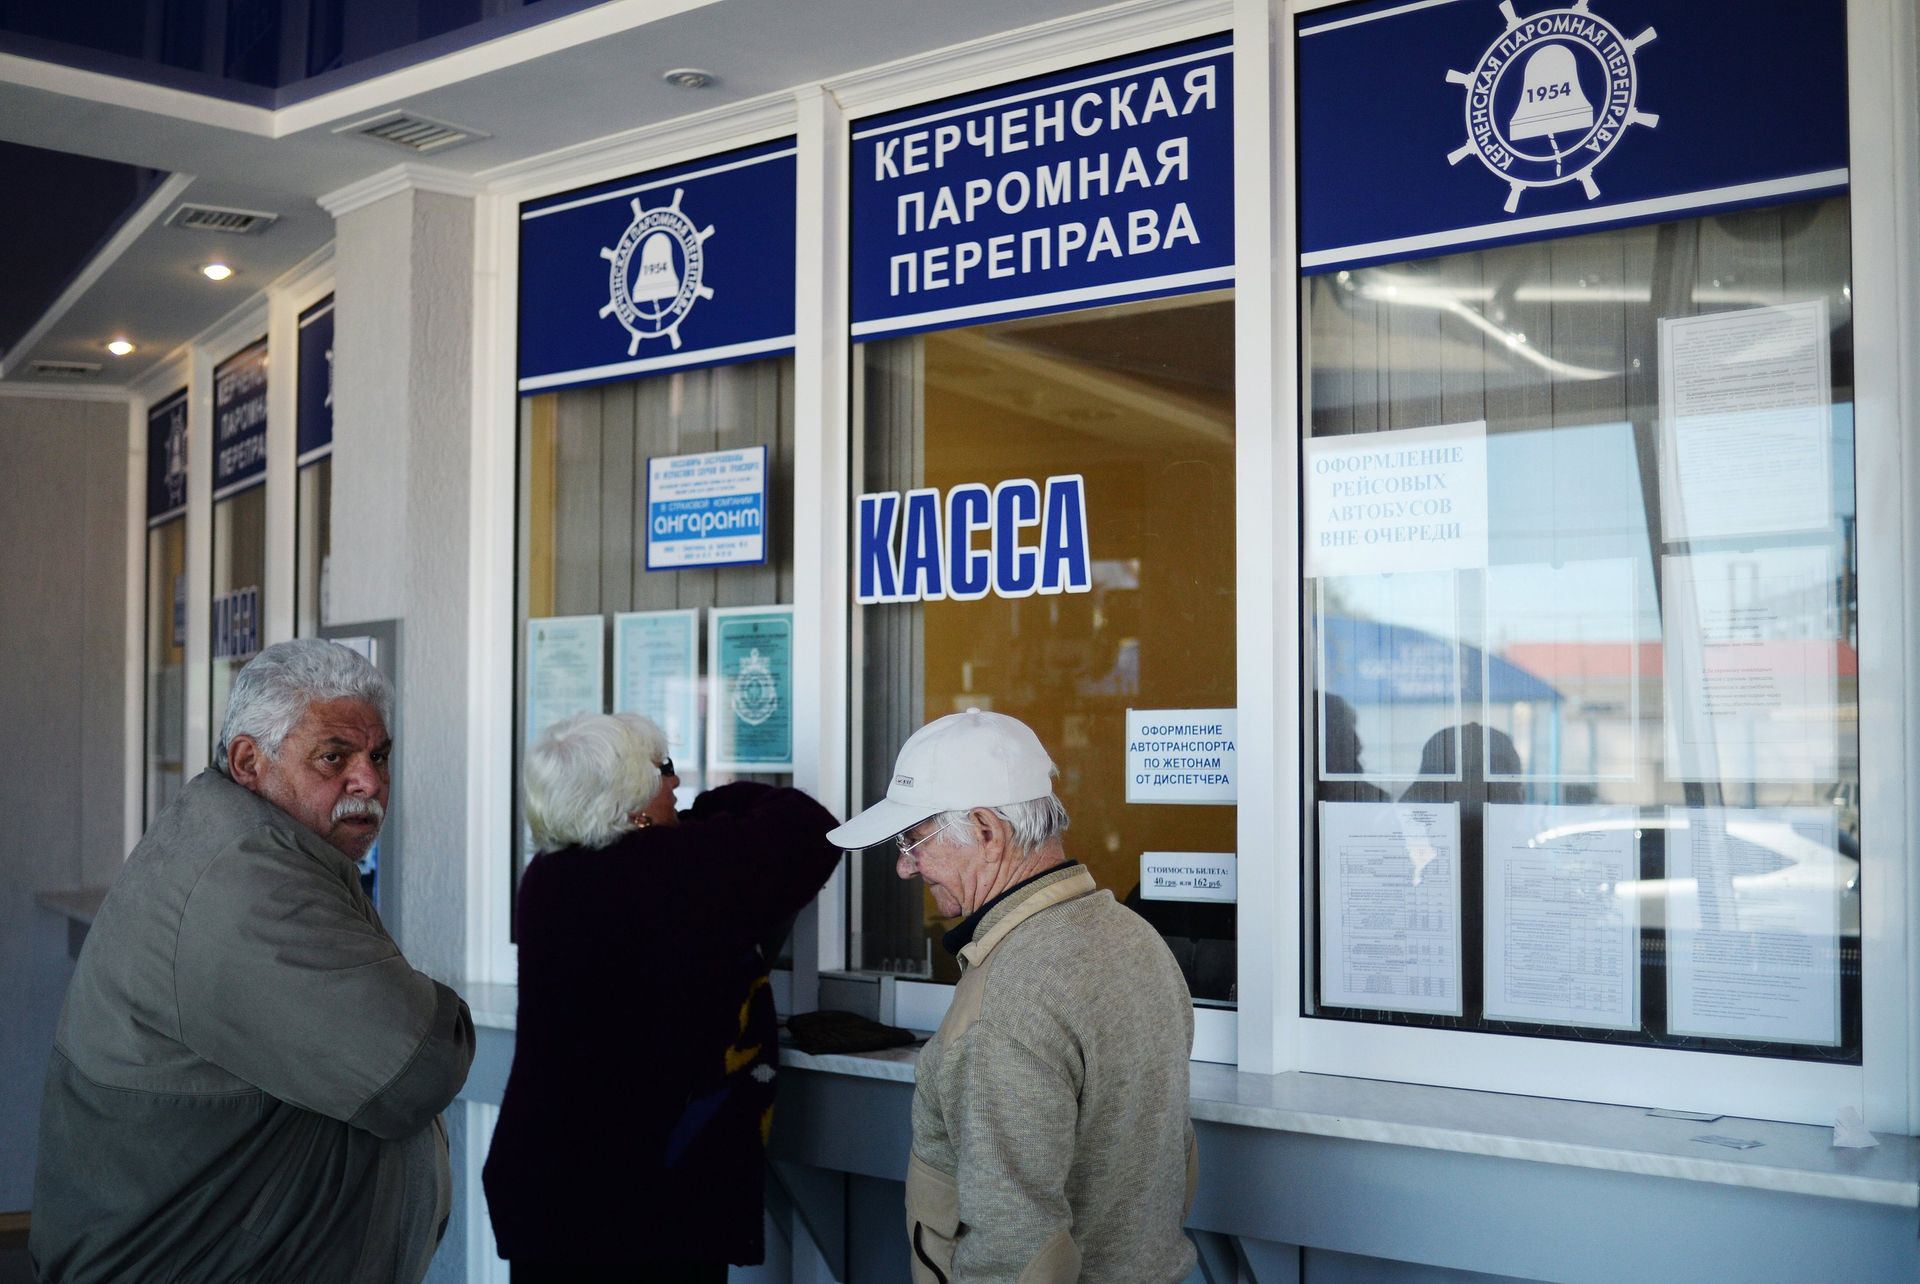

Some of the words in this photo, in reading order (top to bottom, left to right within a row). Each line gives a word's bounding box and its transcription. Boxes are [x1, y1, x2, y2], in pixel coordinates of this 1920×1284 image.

[1473, 56, 1514, 171] КЕРЧЕНСКАЯ
[1499, 14, 1608, 57] ПАРОМНАЯ
[1585, 42, 1630, 153] ПЕРЕПРАВА
[1526, 81, 1571, 104] 1954
[875, 64, 1217, 182] КЕРЧЕНСКАЯ
[897, 136, 1189, 236] ПАРОМНАЯ
[890, 202, 1201, 297] ПЕРЕПРАВА
[1315, 446, 1464, 475] ОФОРМЛЕНИЕ
[1331, 472, 1448, 498] РЕЙСОВЫХ
[1327, 497, 1453, 523] АВТОБУСОВ
[855, 474, 1092, 605] КАССА
[1320, 529, 1359, 547] ВНЕ
[1364, 522, 1462, 545] ОЧЕРЕДИ
[1141, 724, 1223, 736] ОФОРМЛЕНИЕ
[1130, 740, 1236, 753] АВТОТРАНСПОРТА
[1144, 758, 1160, 768] ПО
[1163, 758, 1221, 768] ЖЕТОНАМ
[1136, 774, 1151, 785] ОТ
[1154, 774, 1230, 786] ДИСПЕТЧЕРА
[1147, 866, 1195, 875] СТОИМОСТЬ
[1195, 867, 1229, 875] БИЛЕТА:
[1154, 876, 1164, 886] 40
[1193, 877, 1207, 888] 162
